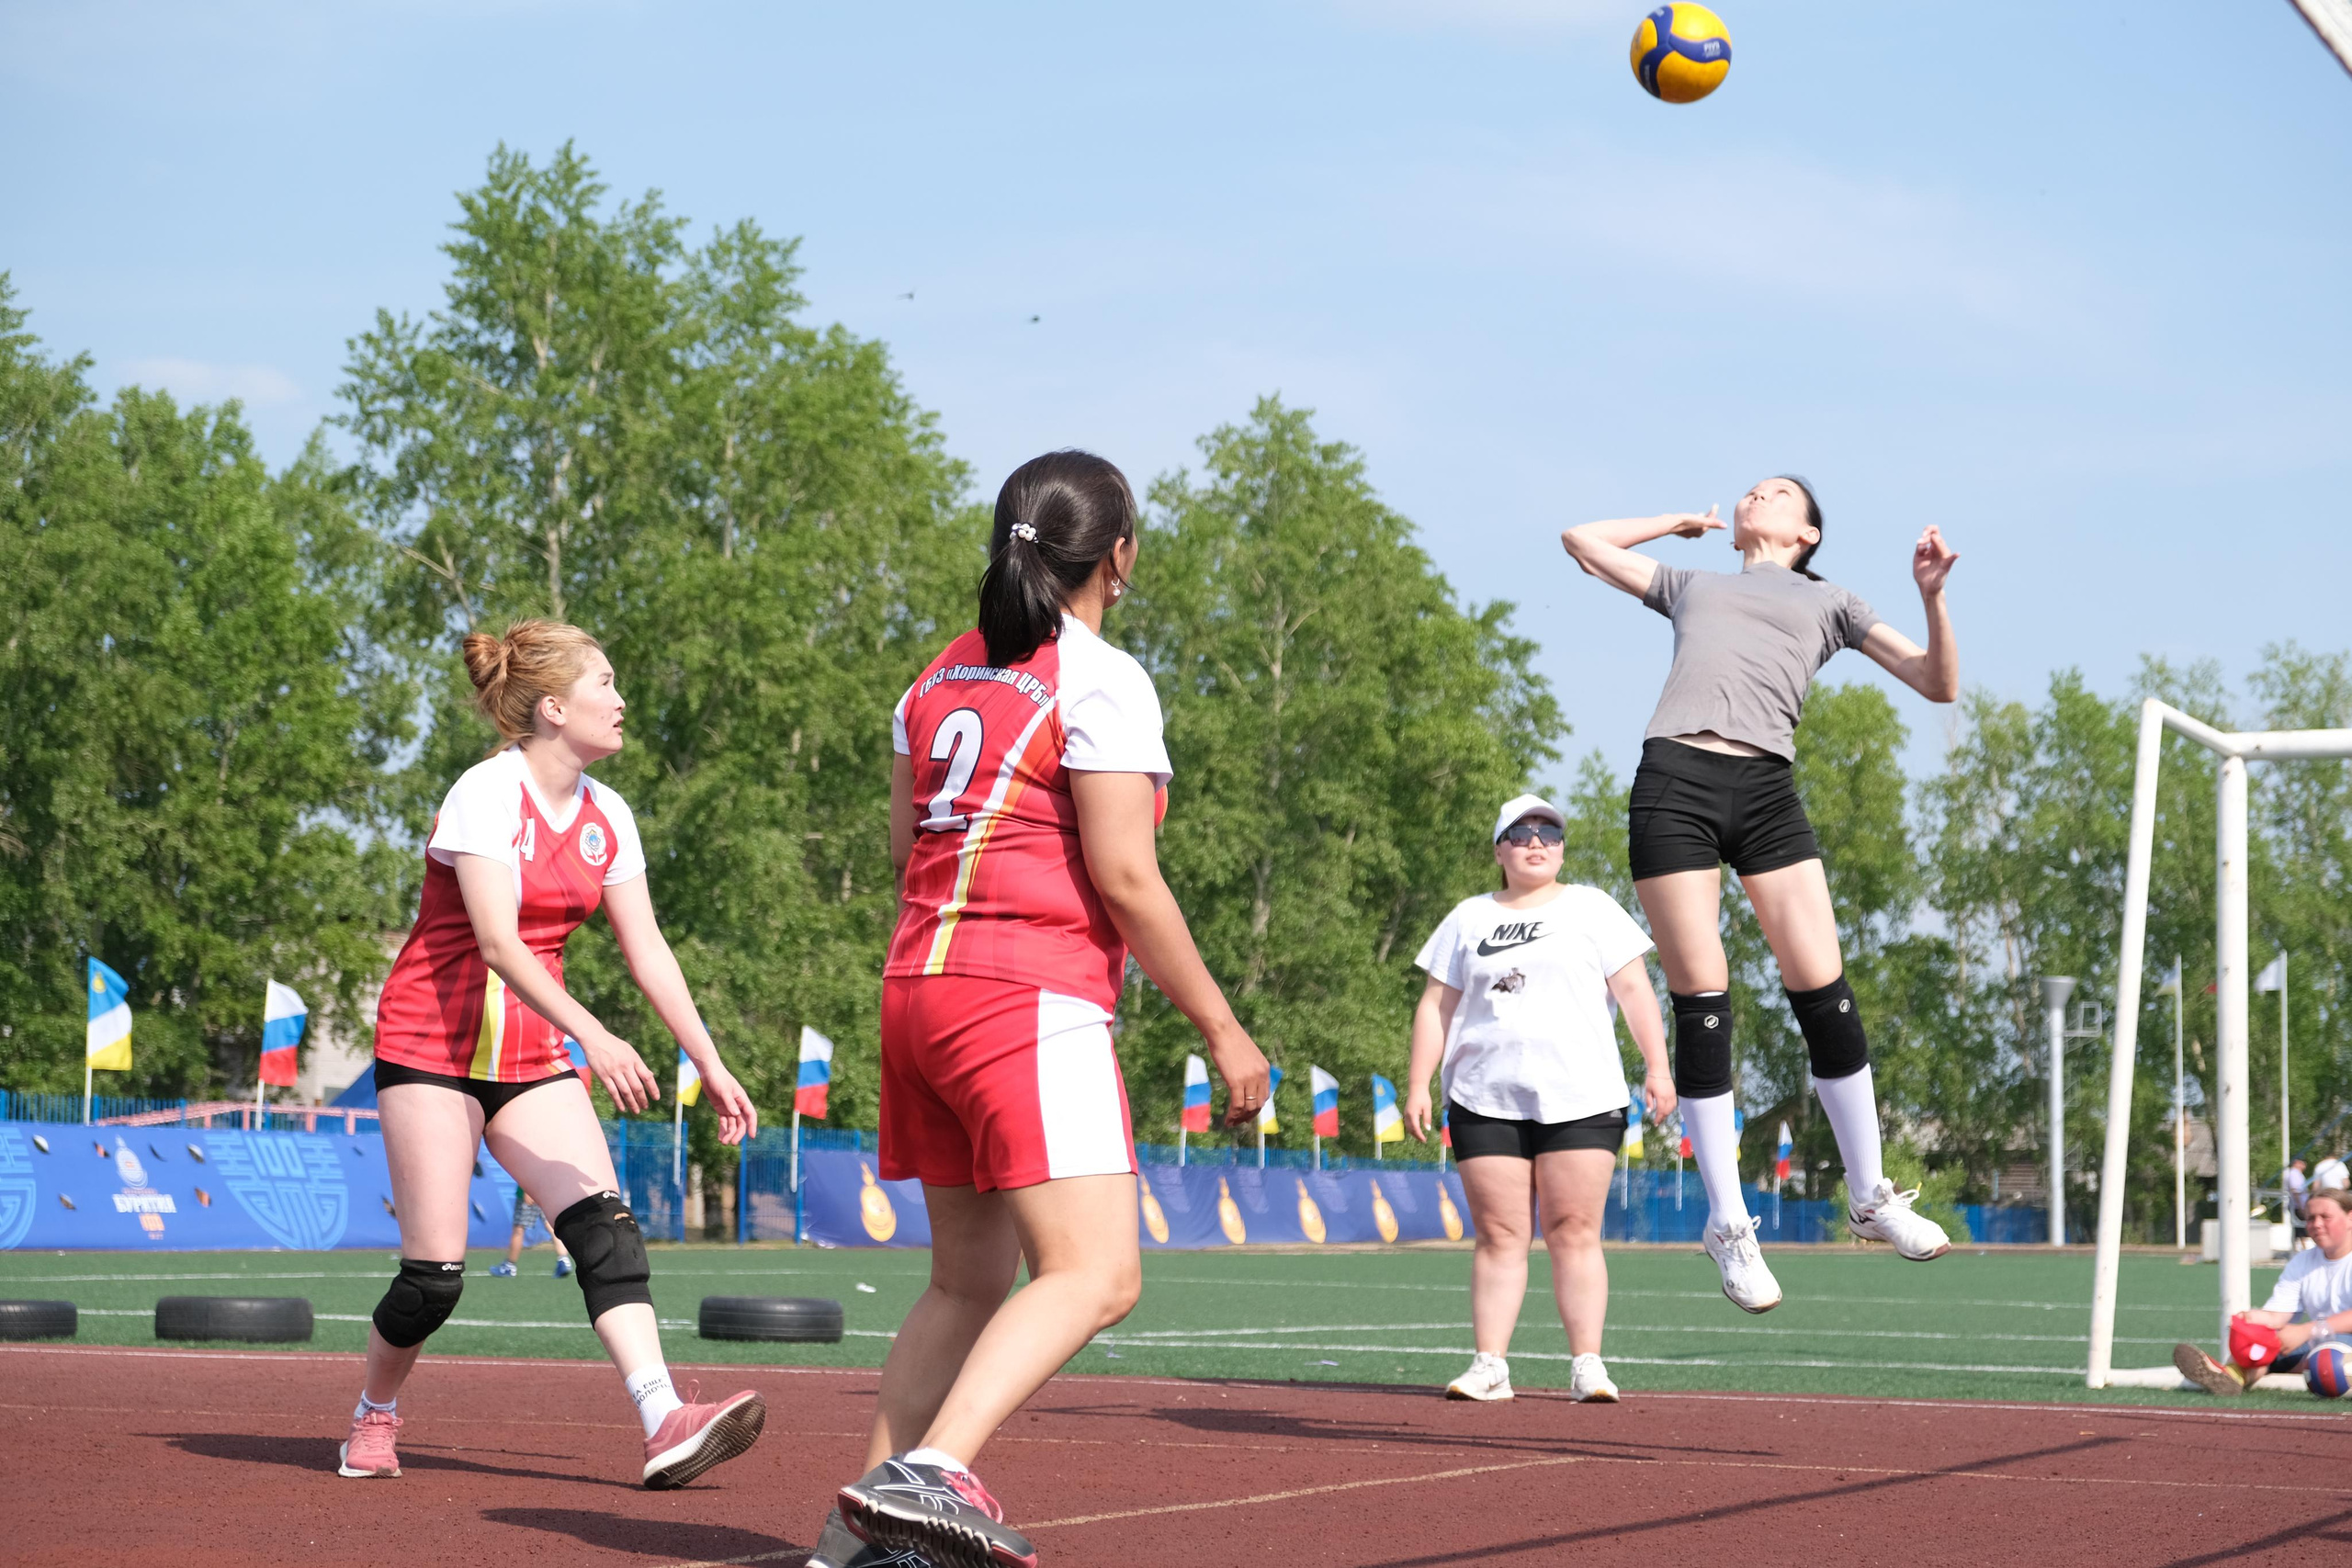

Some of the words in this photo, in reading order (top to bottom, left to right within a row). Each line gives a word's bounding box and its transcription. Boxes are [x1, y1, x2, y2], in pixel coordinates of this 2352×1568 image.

[919, 667, 946, 699] ГБУЗ
[945, 663, 1021, 685] «Хоринская
[1014, 671, 1050, 707] ЦРБ»
[920, 706, 984, 832] 2
[1491, 921, 1544, 942] NIKE
